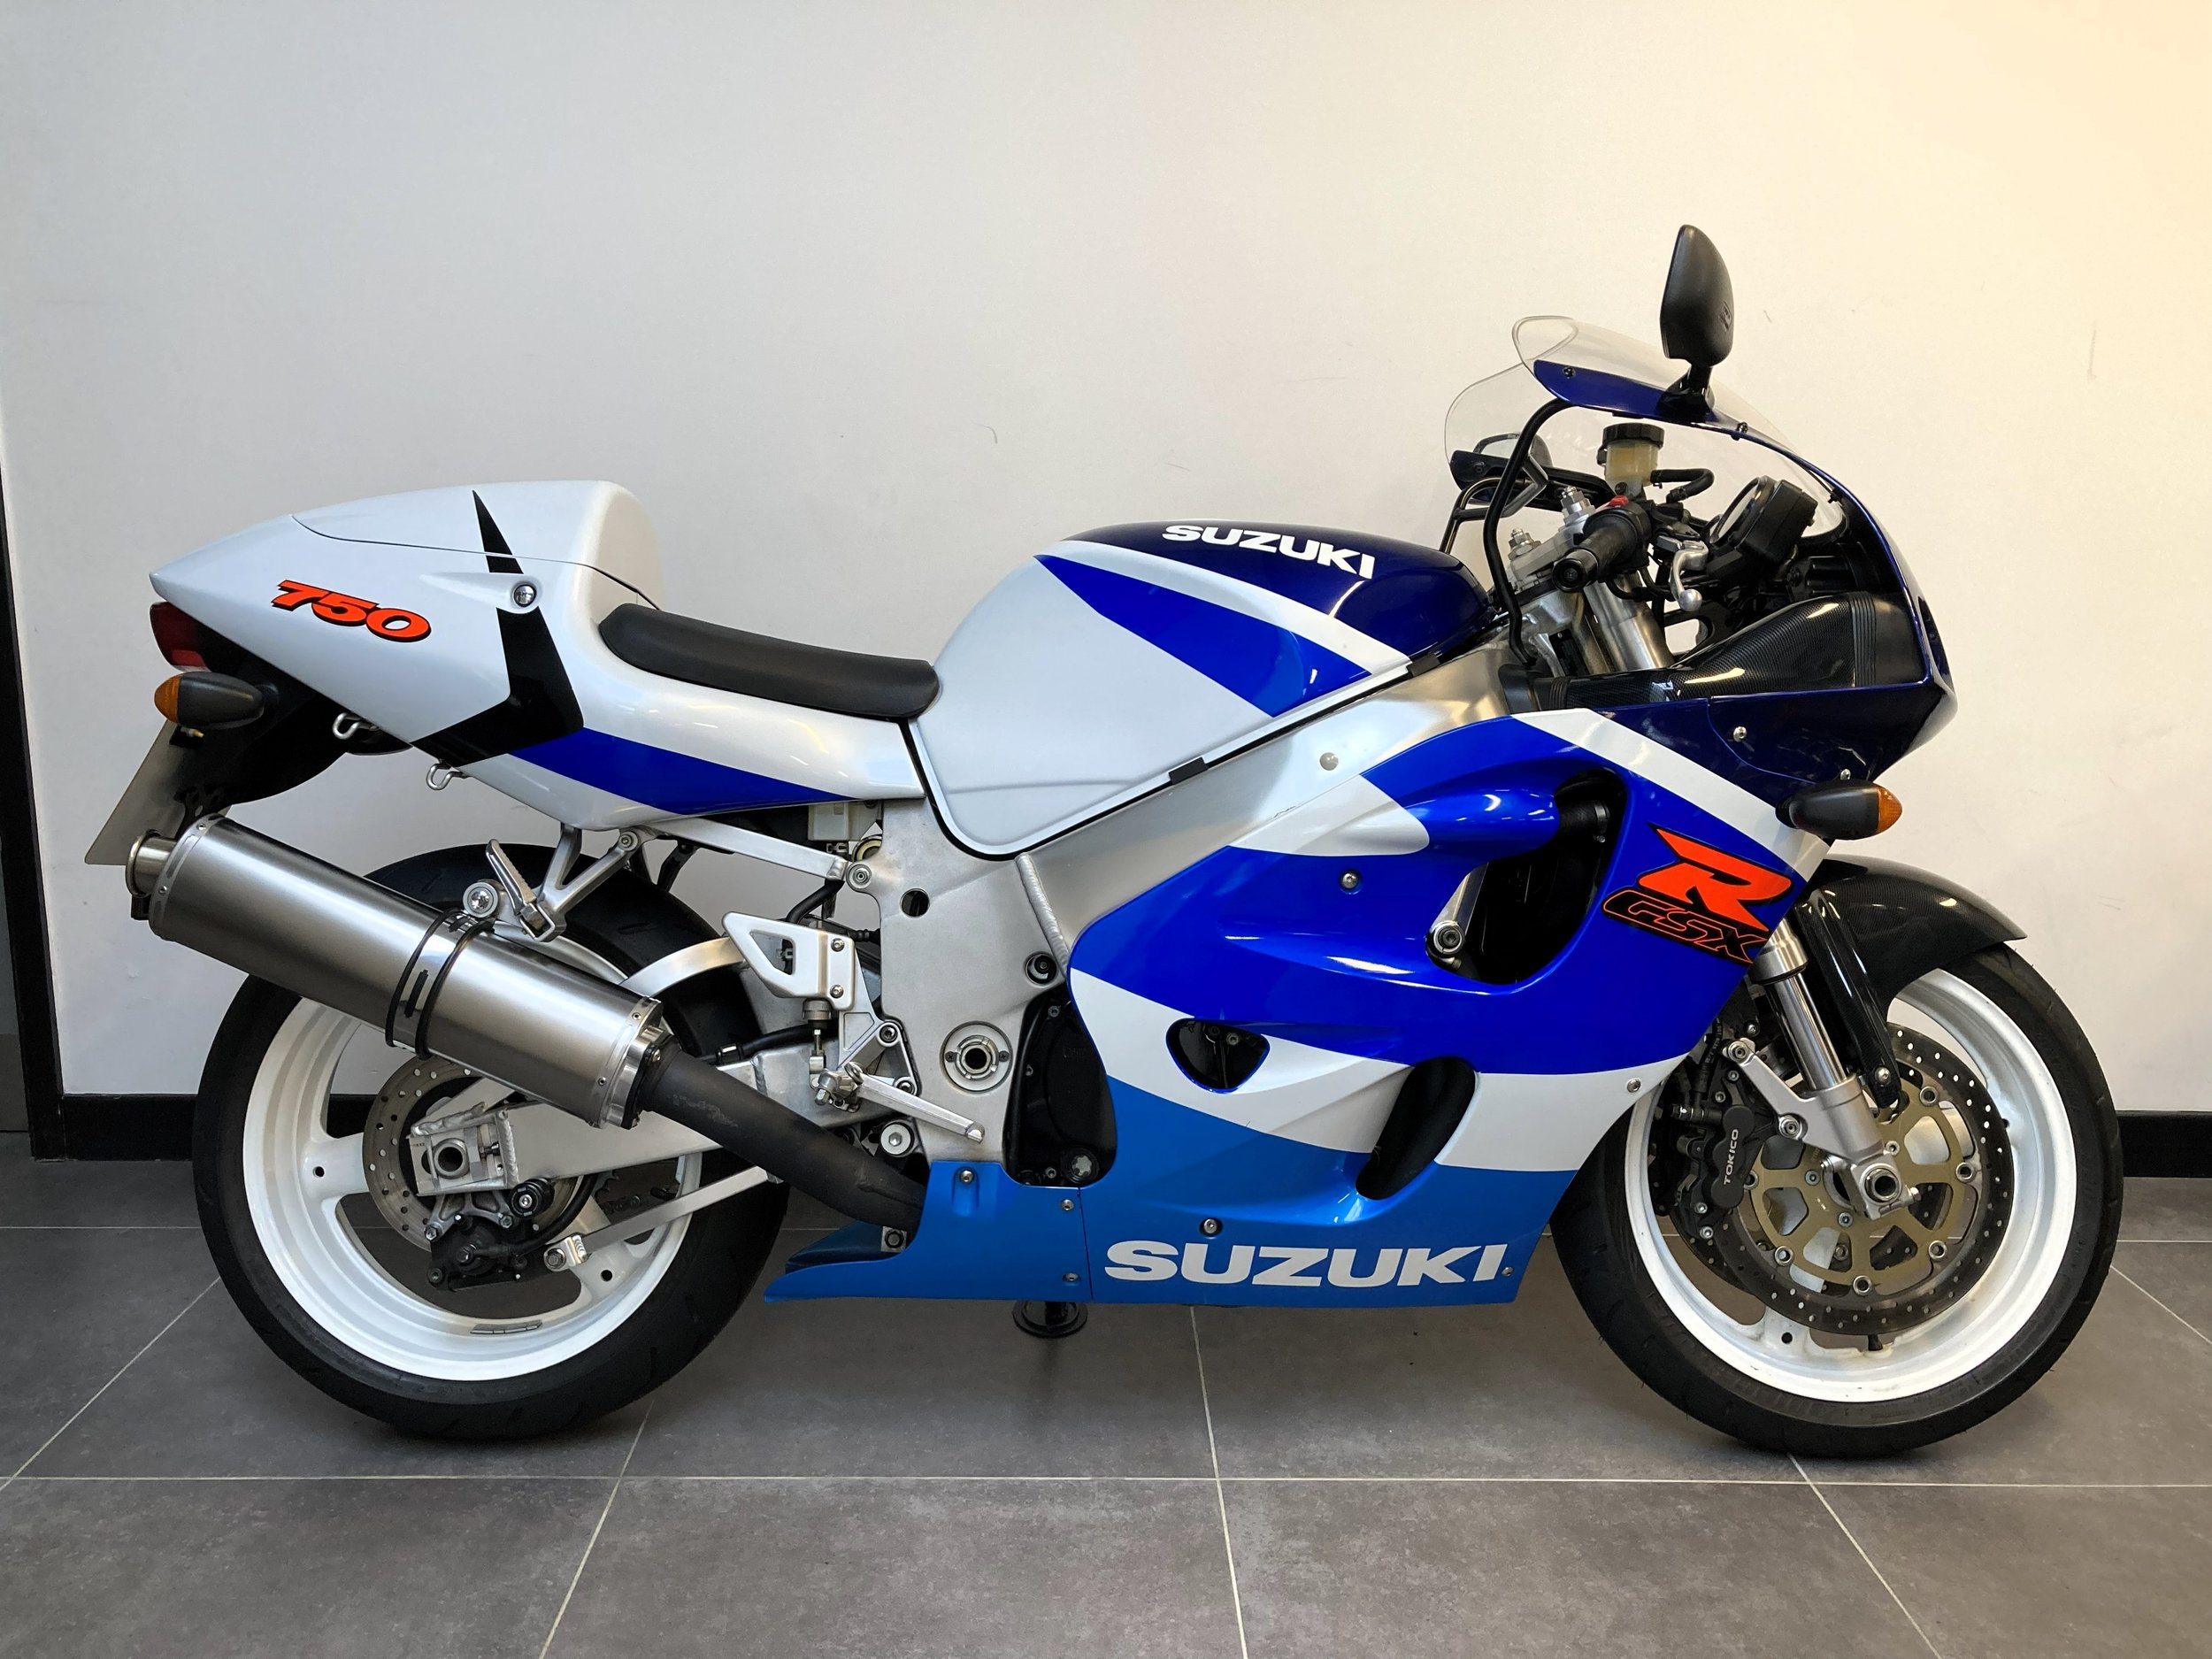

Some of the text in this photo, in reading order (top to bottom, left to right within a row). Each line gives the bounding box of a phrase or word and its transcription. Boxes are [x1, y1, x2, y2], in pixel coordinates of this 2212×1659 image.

[1162, 525, 1375, 580] SUZUKI
[271, 580, 432, 642] 750
[1639, 828, 1793, 933] R
[1602, 888, 1769, 964] GSX
[1723, 1128, 1739, 1185] TOKICO
[1104, 1240, 1508, 1287] SUZUKI
